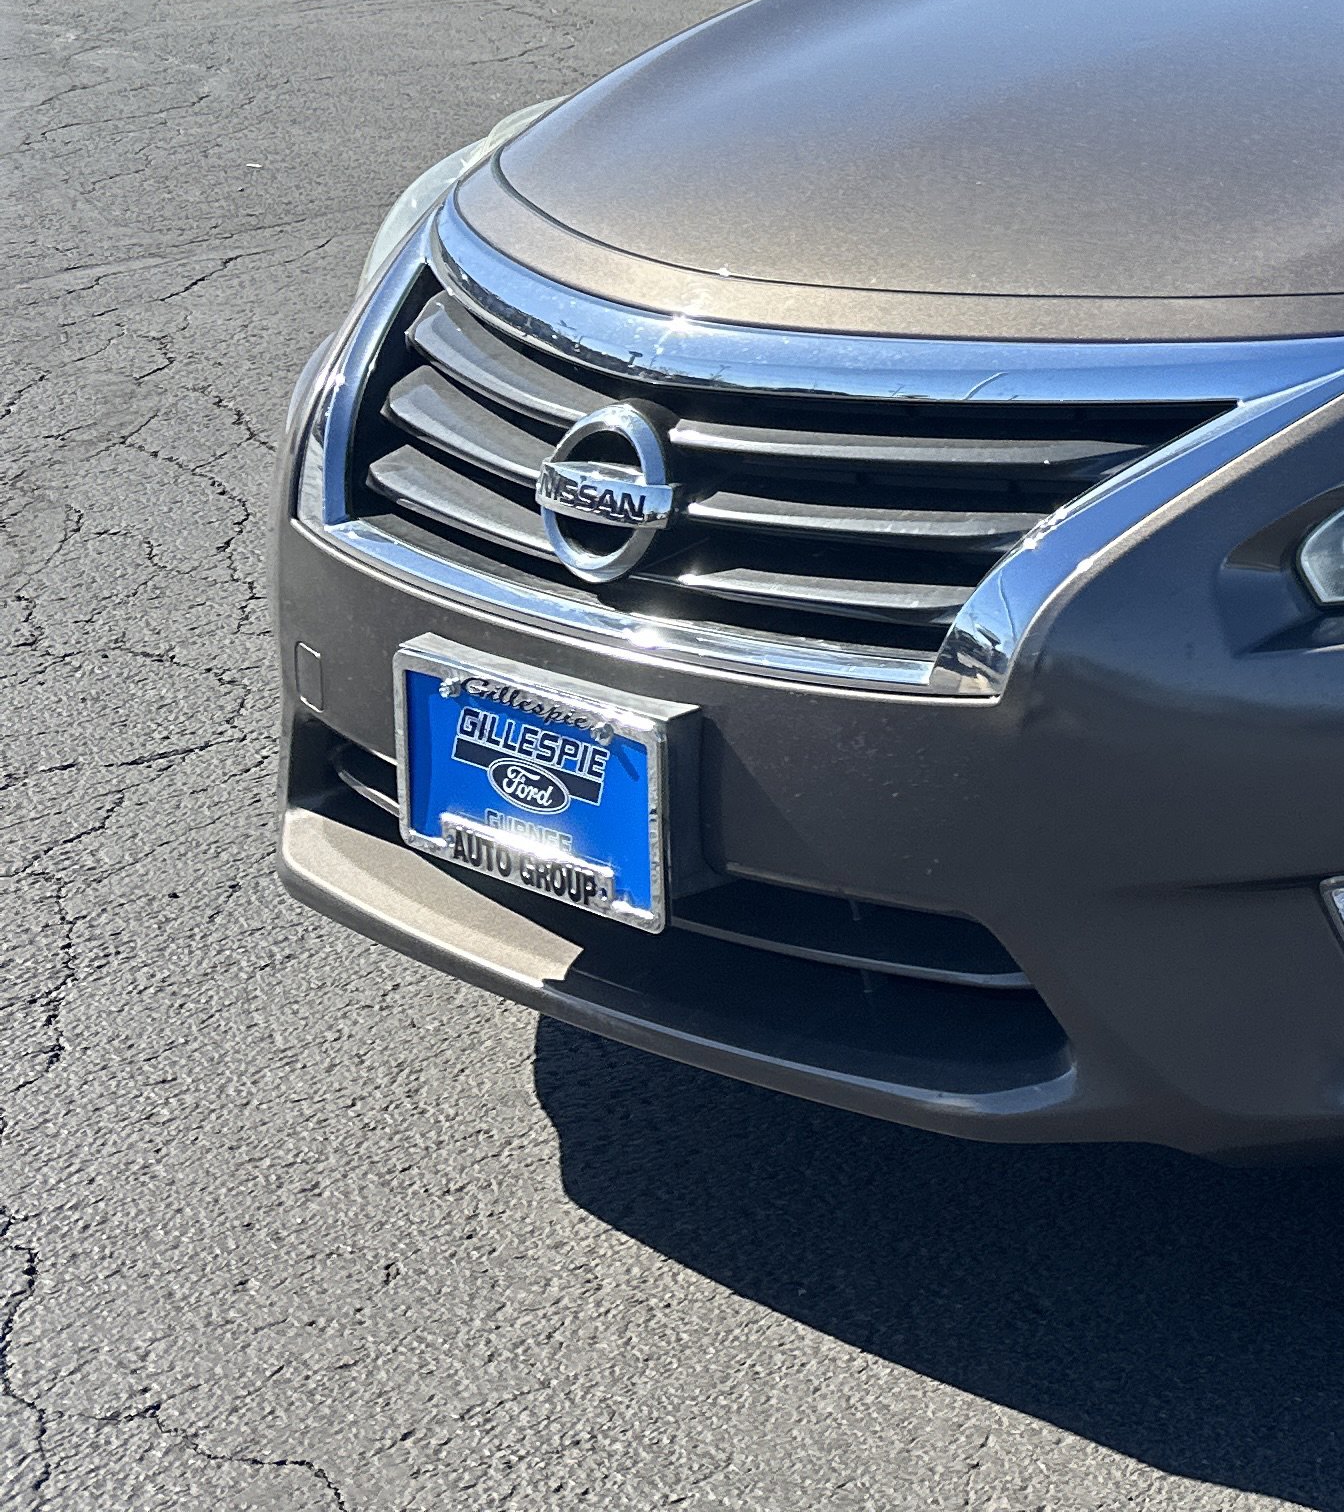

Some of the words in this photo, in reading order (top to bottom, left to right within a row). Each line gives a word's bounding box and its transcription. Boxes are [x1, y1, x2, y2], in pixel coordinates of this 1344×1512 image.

[538, 462, 647, 525] NISSAN
[460, 676, 593, 730] Gillespie
[459, 706, 611, 780] GILLESPIE
[502, 765, 553, 807] Ford
[453, 827, 512, 877] AUTO
[520, 853, 597, 906] GROUP
